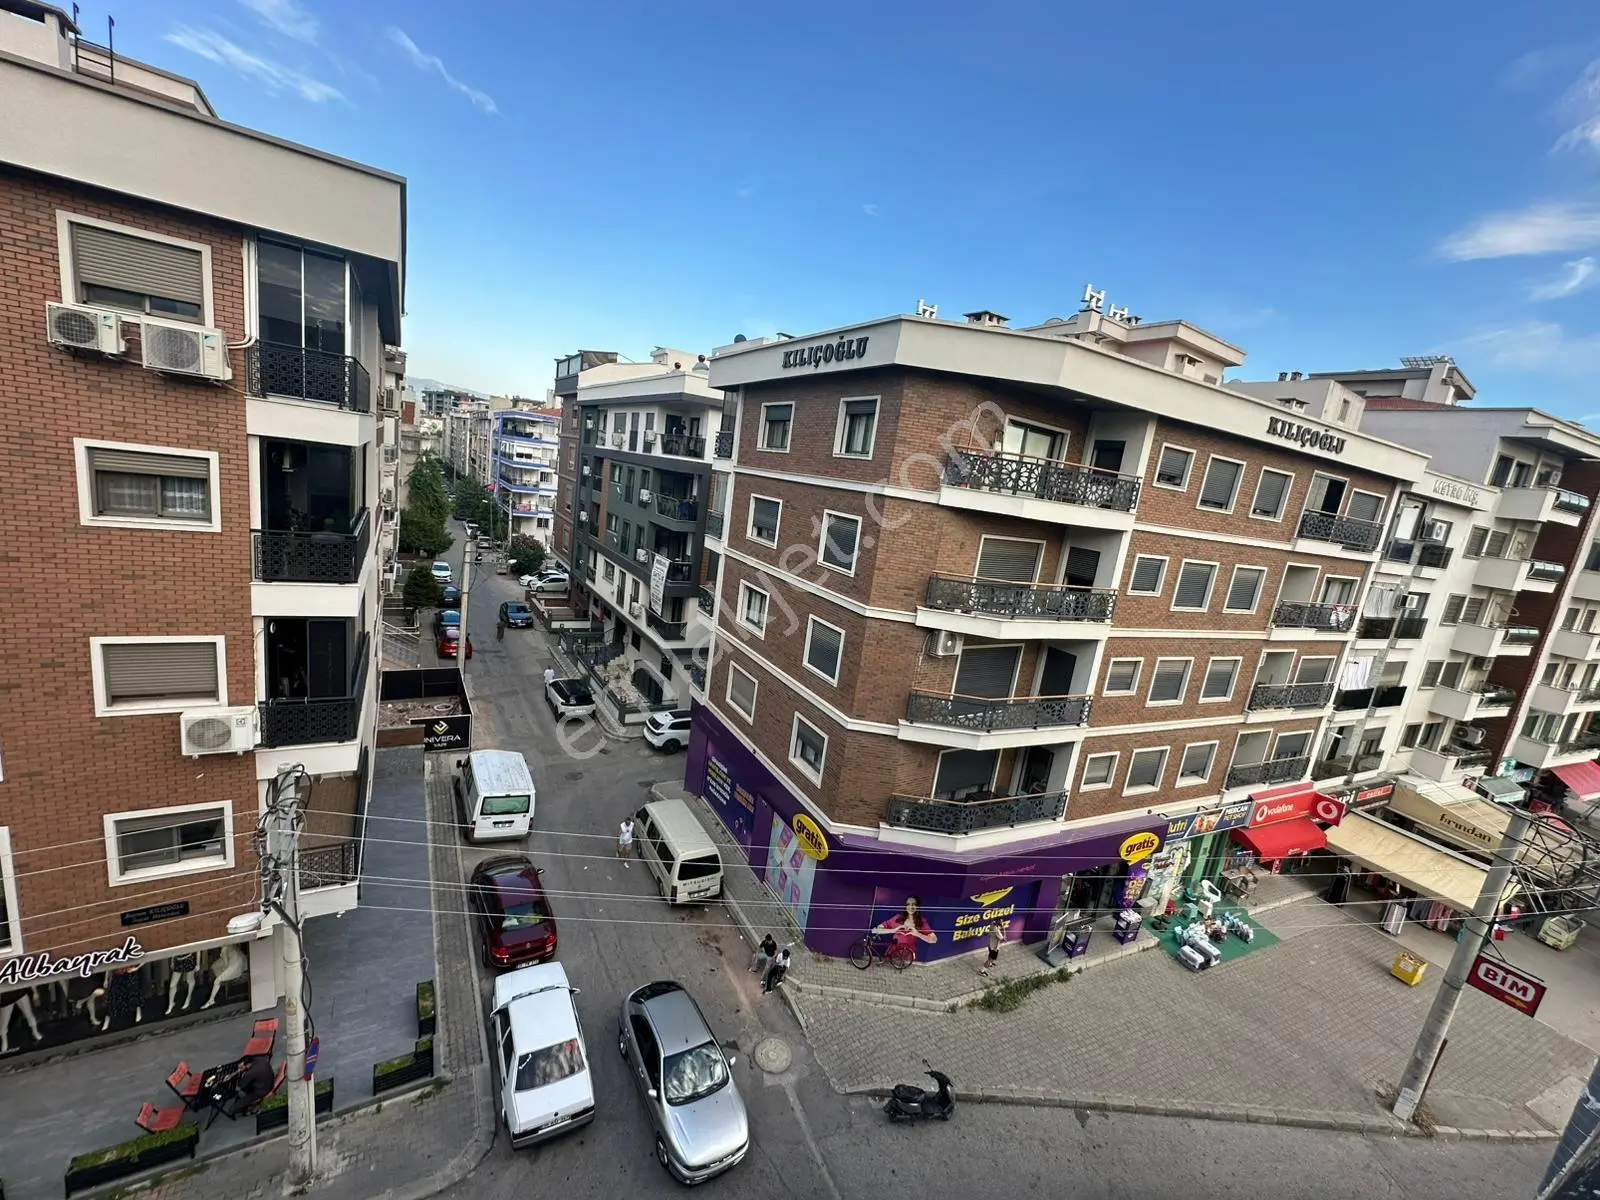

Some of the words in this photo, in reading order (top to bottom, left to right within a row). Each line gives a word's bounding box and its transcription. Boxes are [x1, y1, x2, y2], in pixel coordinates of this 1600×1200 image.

[782, 335, 869, 369] KILIÇOĞLU
[1267, 416, 1347, 454] KILIÇOĞLU
[1433, 479, 1463, 500] METRO
[1267, 803, 1294, 816] vodafone
[796, 819, 823, 853] gratis
[1125, 836, 1155, 857] gratis
[955, 915, 981, 927] Size
[982, 904, 1015, 920] Güzel
[0, 936, 145, 985] Albayrak
